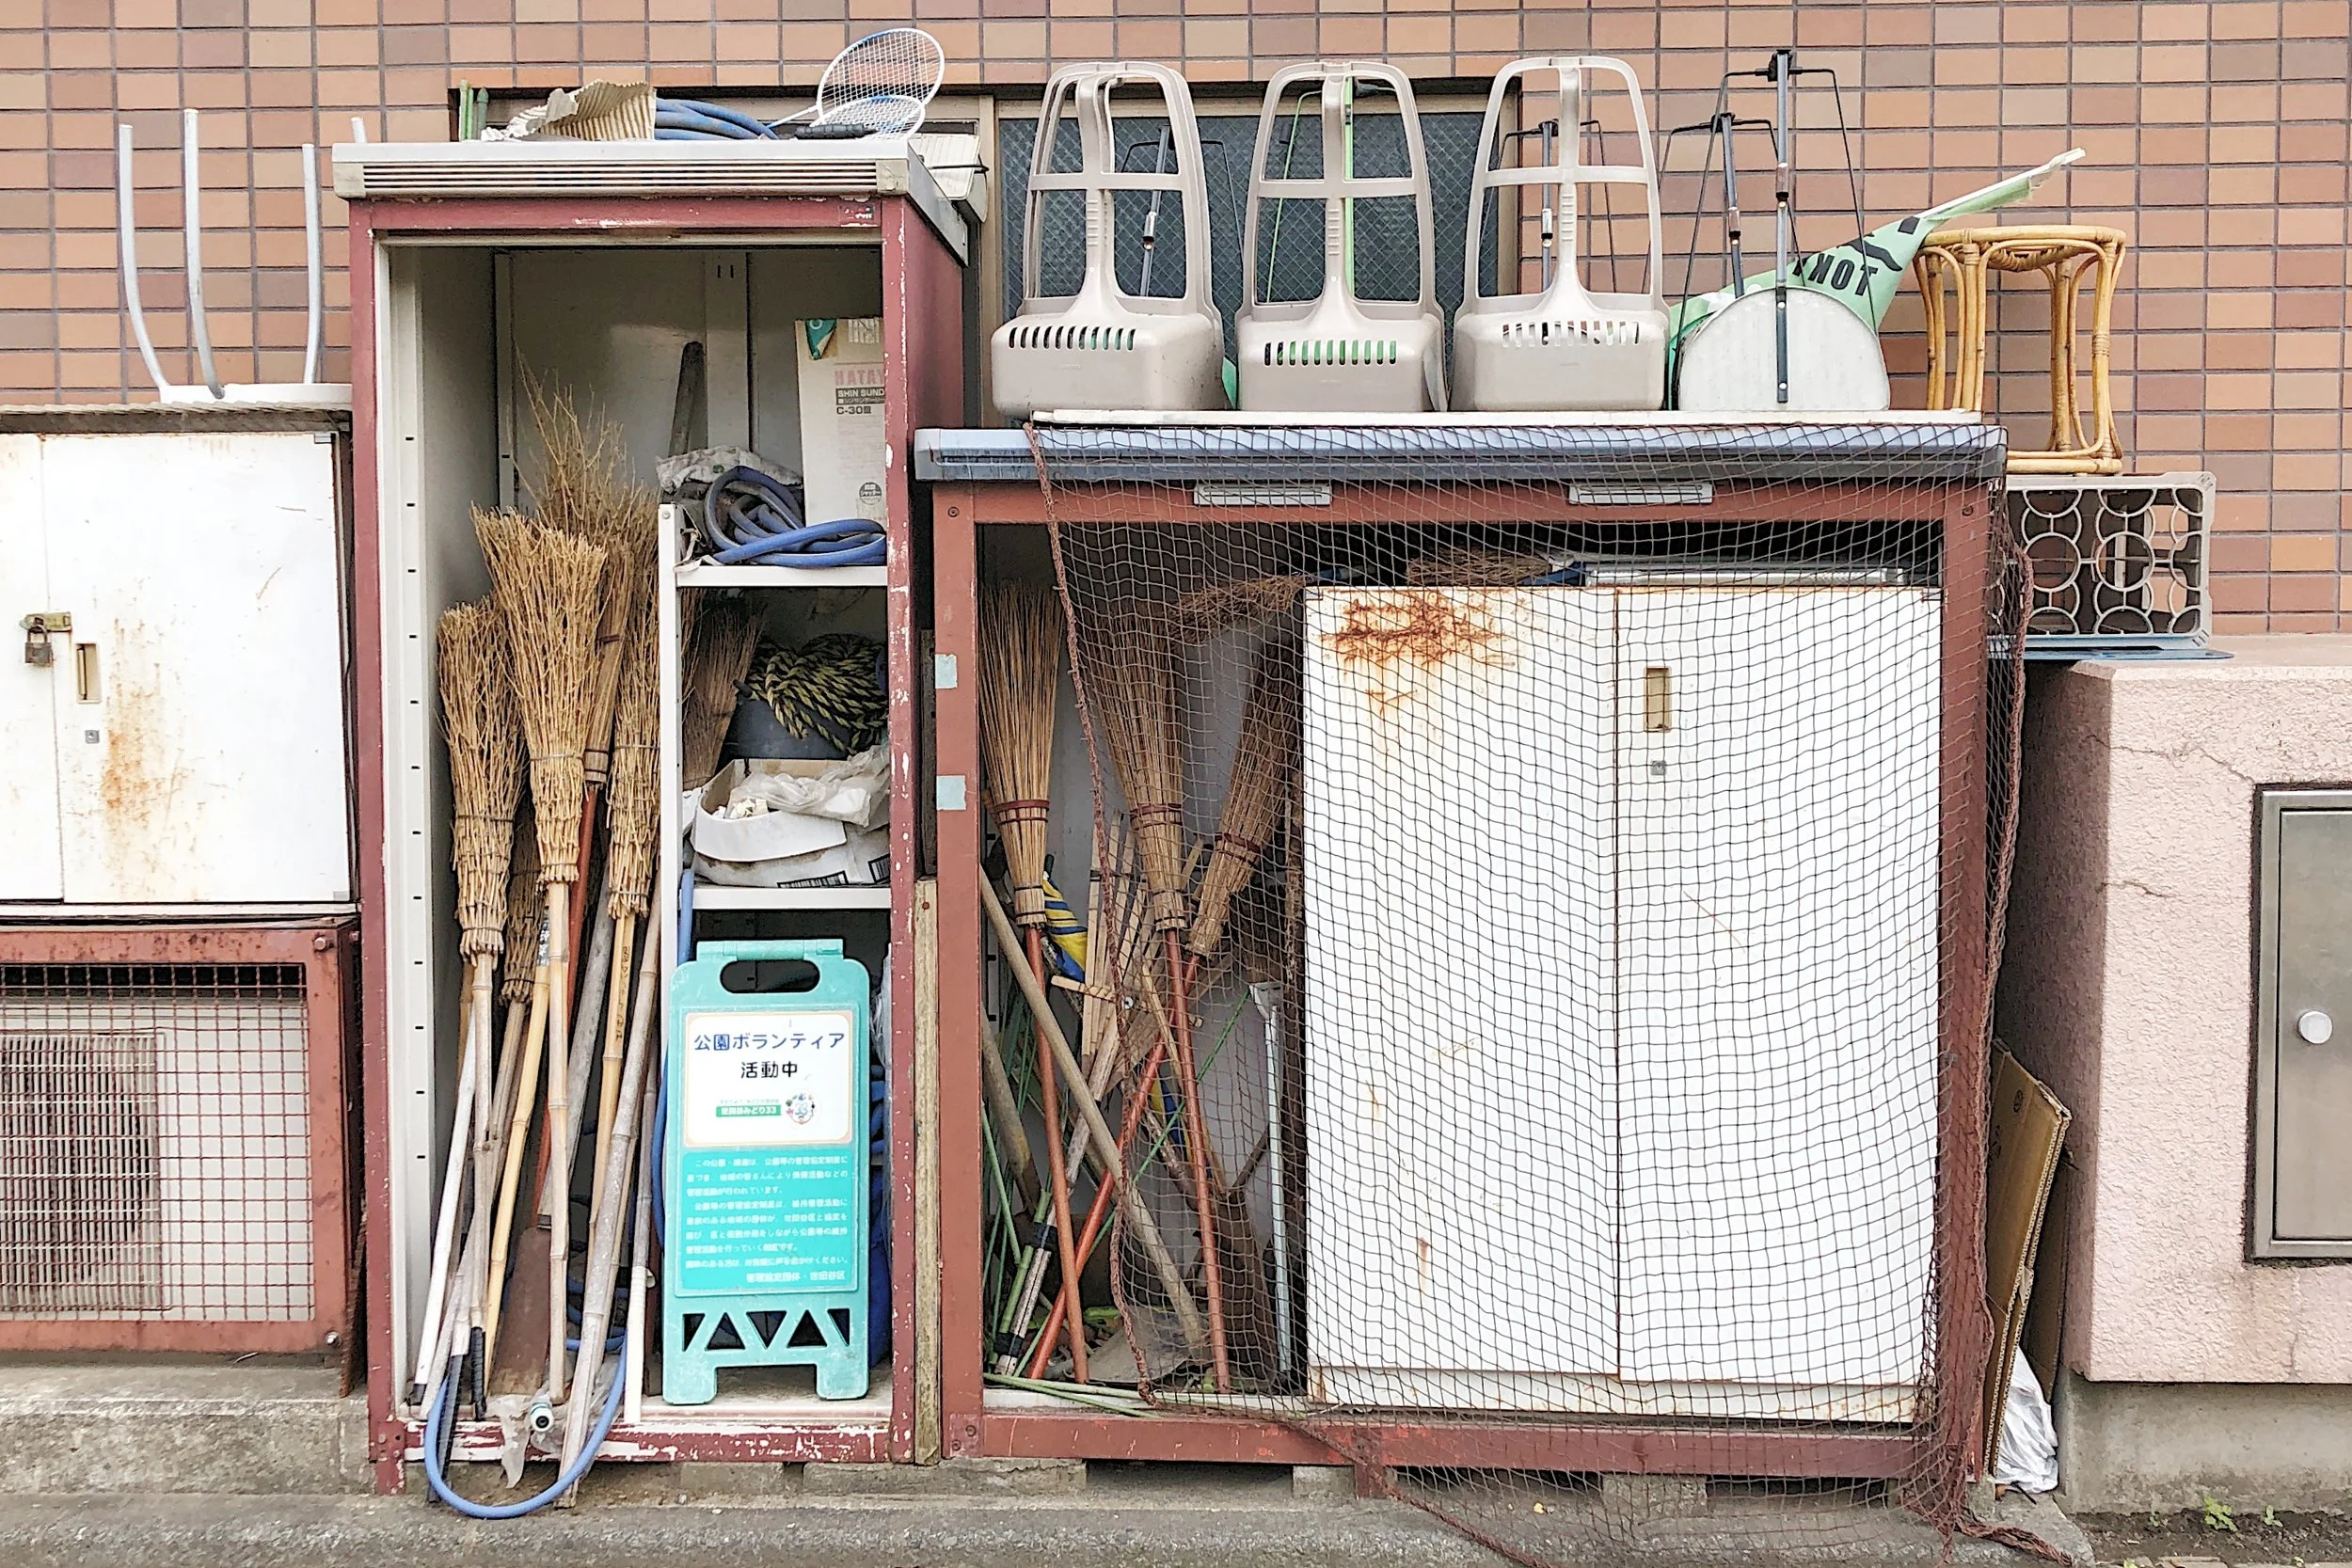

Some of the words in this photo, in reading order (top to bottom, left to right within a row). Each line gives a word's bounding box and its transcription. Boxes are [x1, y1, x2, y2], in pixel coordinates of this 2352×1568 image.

[837, 388, 858, 398] SHIN
[694, 1033, 845, 1051] 公園ボランティア
[740, 1061, 798, 1079] 活動中
